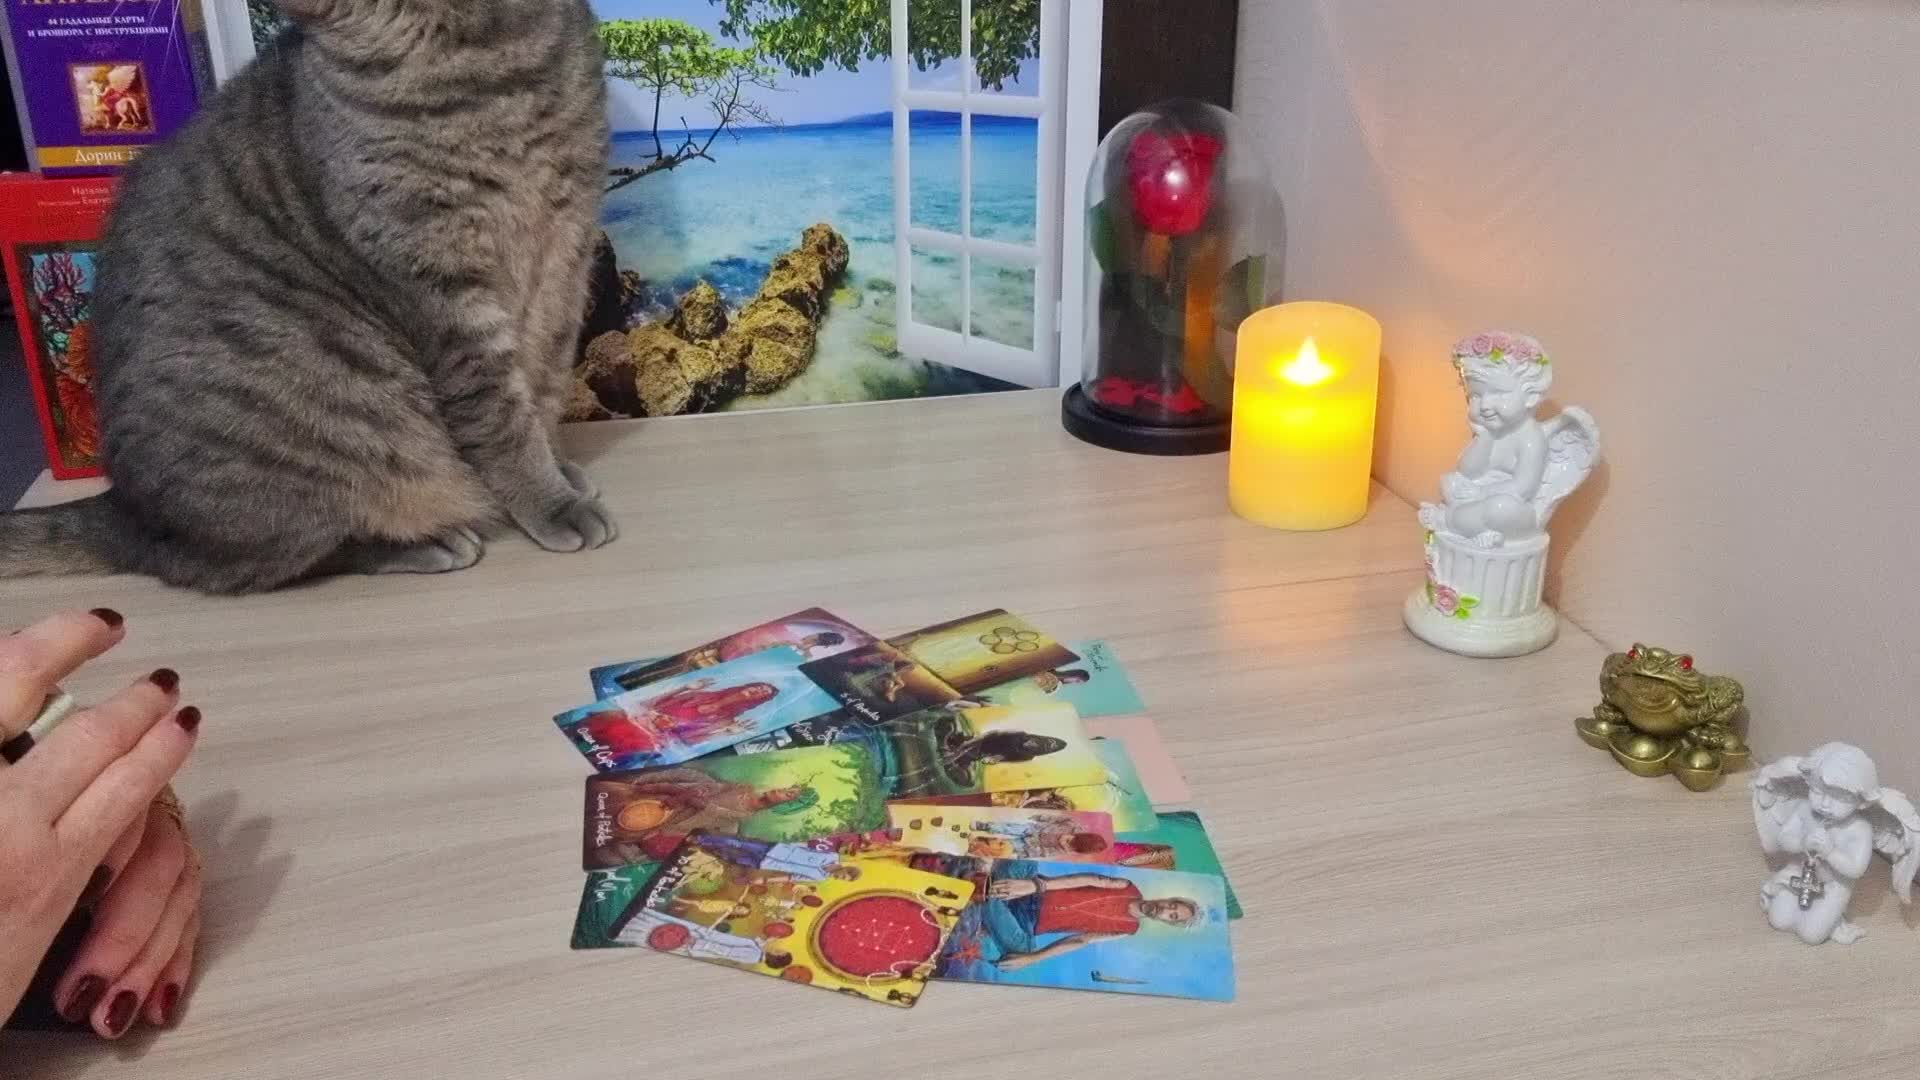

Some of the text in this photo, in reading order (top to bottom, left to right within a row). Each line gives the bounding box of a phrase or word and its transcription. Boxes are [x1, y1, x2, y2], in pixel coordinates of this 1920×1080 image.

[60, 16, 112, 25] ГАДАЛЬНЫЕ
[114, 16, 145, 24] КАРТЫ
[37, 28, 84, 37] БРОШЮРА
[94, 26, 169, 36] ИНСТРУКЦИЯМИ
[75, 149, 122, 165] Дорин
[596, 751, 617, 768] Cups
